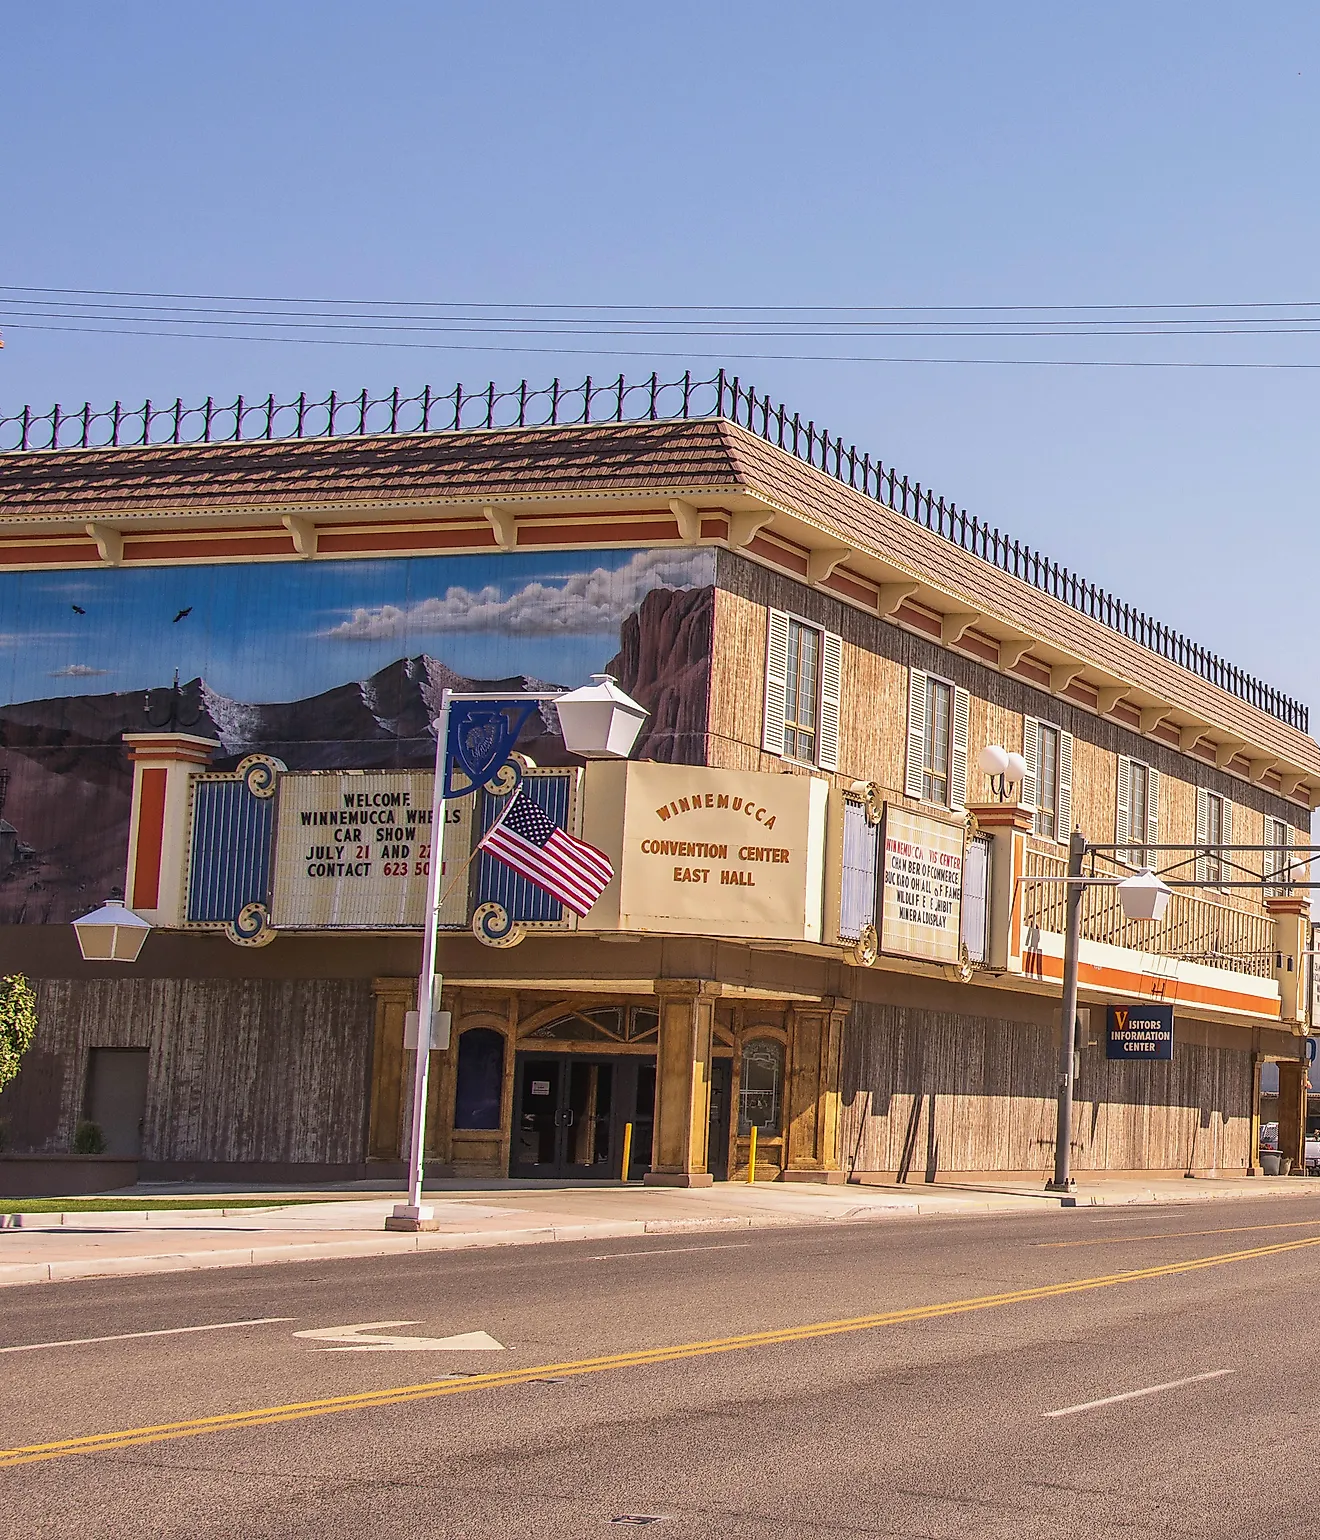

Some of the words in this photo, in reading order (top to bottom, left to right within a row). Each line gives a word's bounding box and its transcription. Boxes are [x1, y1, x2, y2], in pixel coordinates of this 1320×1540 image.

[344, 793, 410, 807] WELCOME
[301, 811, 395, 826] WINNEMUCCA
[406, 809, 461, 824] WHELS
[656, 793, 777, 830] WINNEMUCCA
[334, 828, 362, 842] CAR
[376, 827, 416, 842] SHOW
[306, 846, 345, 860] JULY
[356, 845, 370, 859] 21
[381, 845, 410, 859] AND
[641, 839, 728, 859] CONVENTION
[738, 846, 790, 863] CENTER
[307, 862, 371, 877] CONTACT
[383, 862, 408, 876] 623
[414, 861, 446, 876] 501
[940, 853, 961, 870] CENTER
[673, 867, 710, 883] EAST
[720, 870, 755, 886] HALL
[945, 886, 960, 900] FAME
[1115, 1011, 1161, 1030] VISITORS
[1111, 1031, 1170, 1041] INFORMATION
[1123, 1042, 1156, 1052] CENTER
